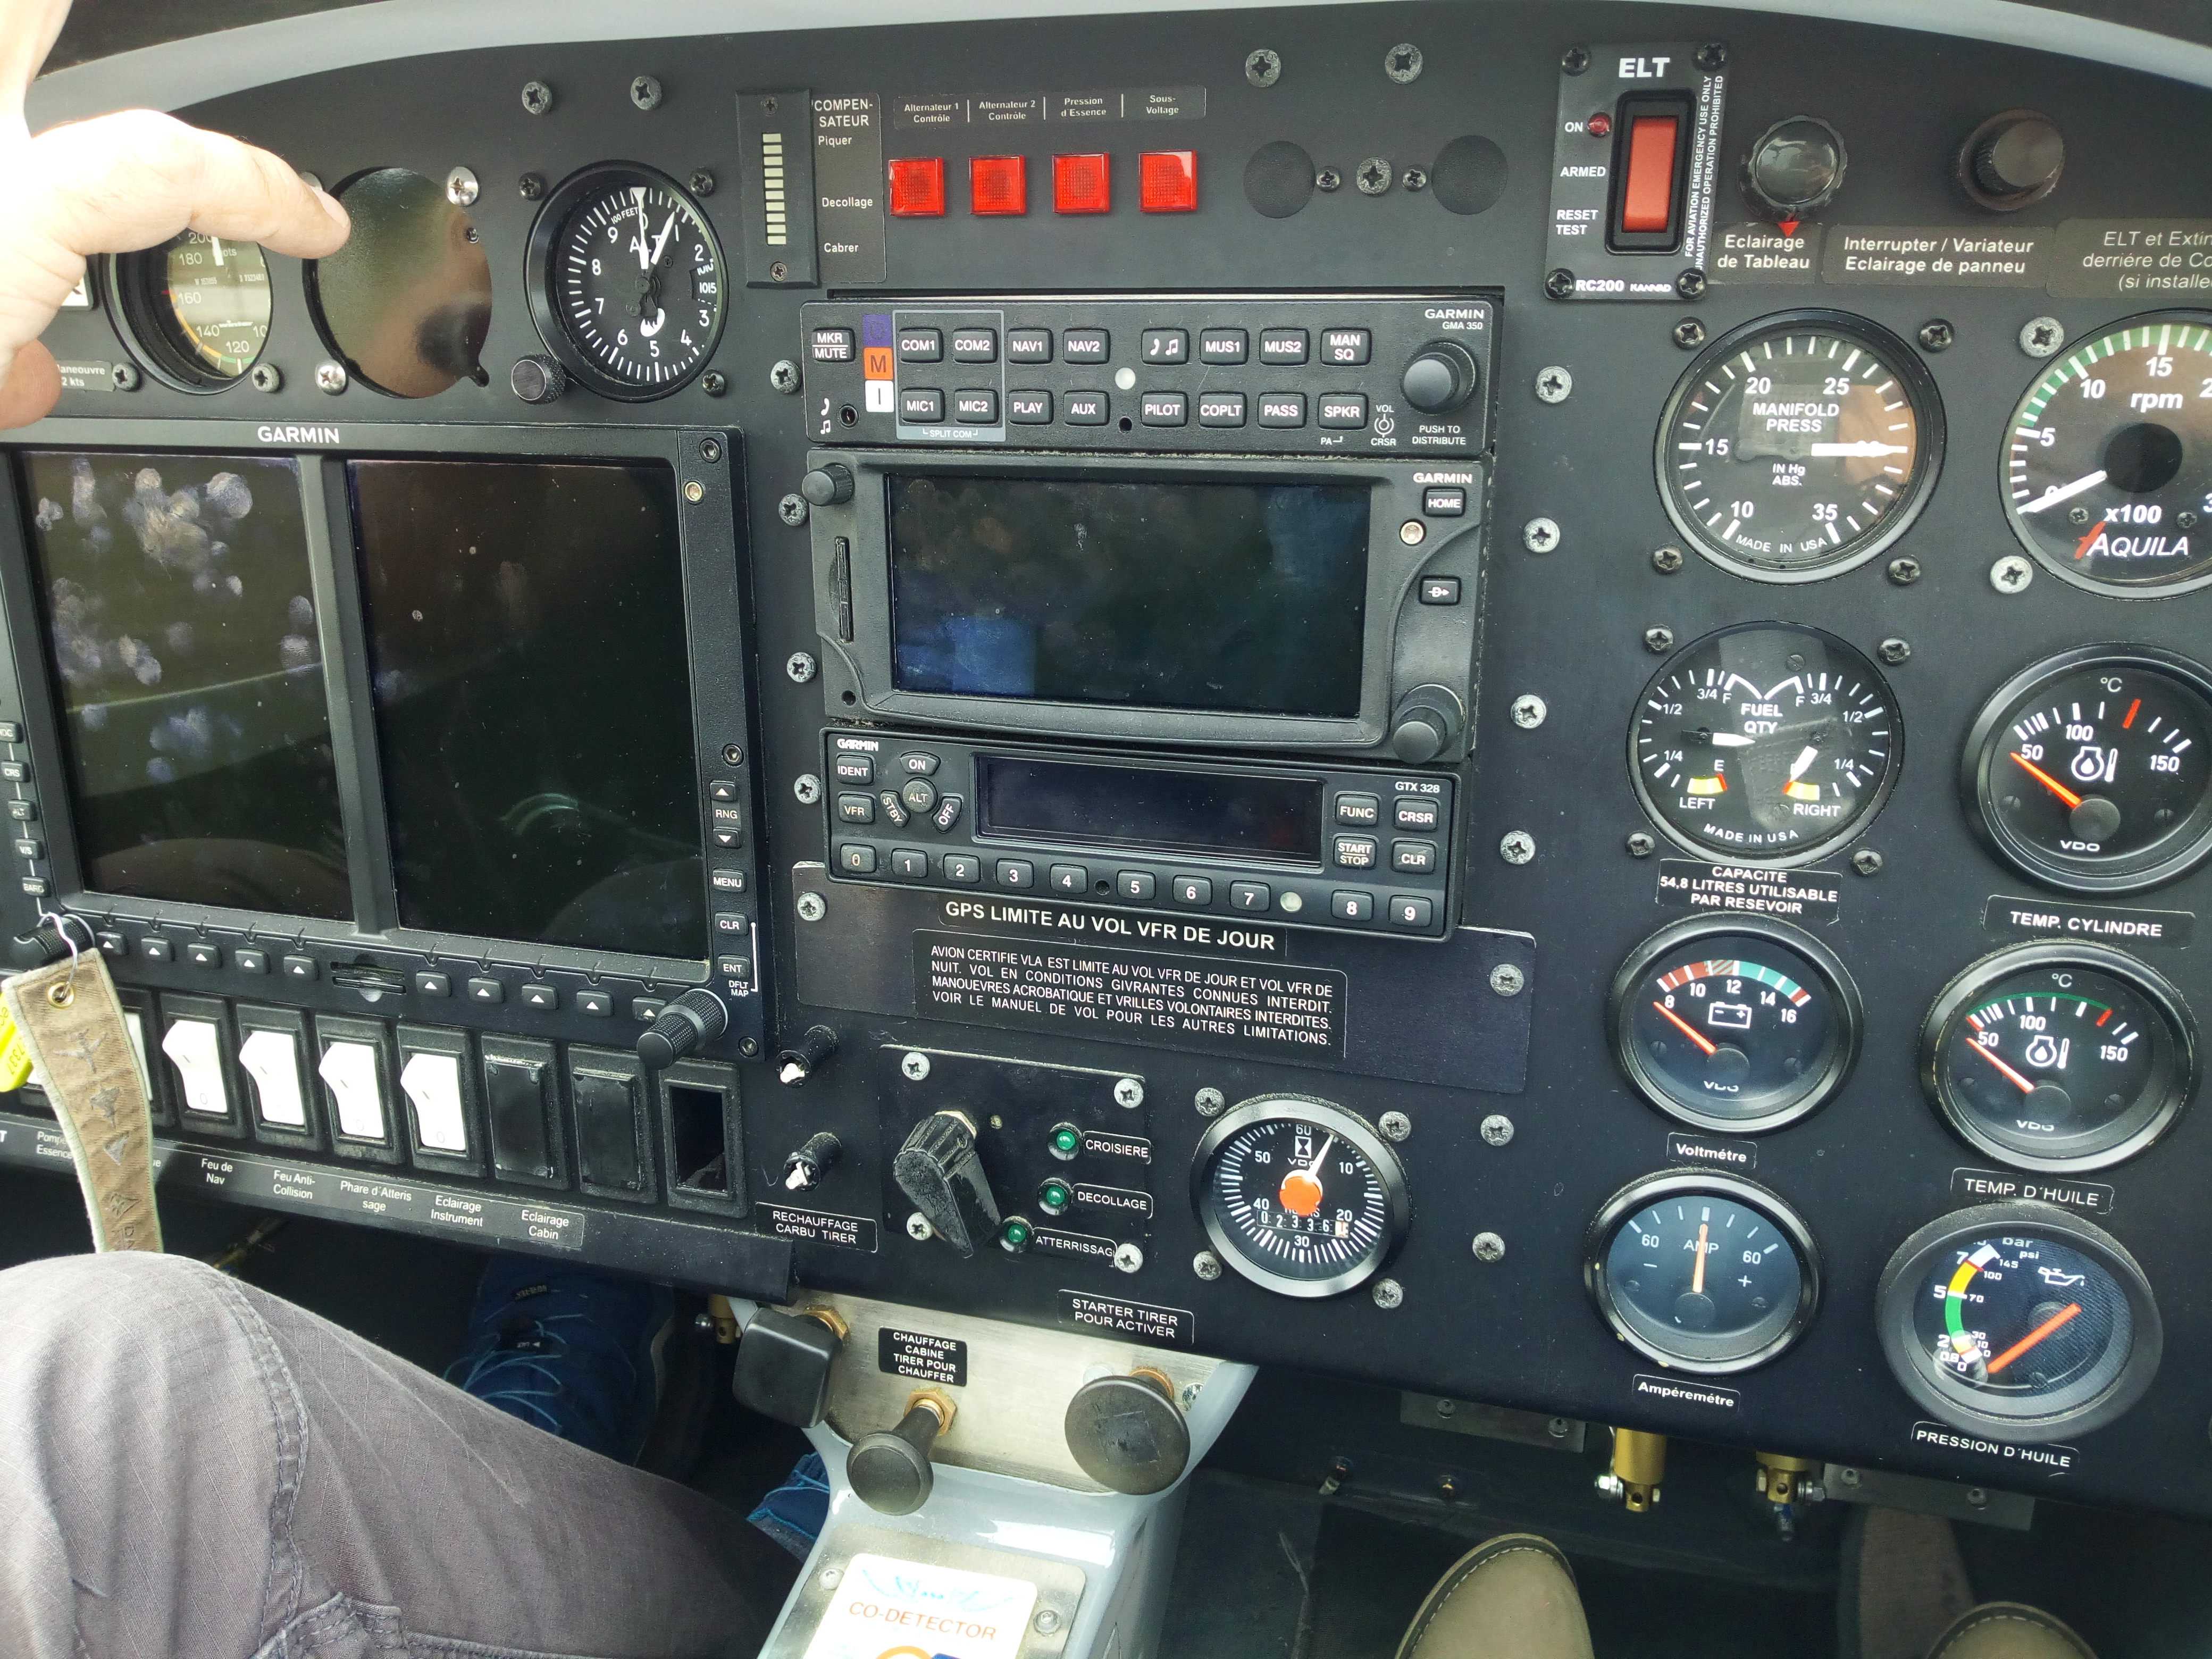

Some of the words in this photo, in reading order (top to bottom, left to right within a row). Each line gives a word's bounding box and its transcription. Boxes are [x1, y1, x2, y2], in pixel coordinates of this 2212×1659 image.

[1619, 57, 1670, 78] ELT
[1702, 76, 1711, 102] ONLY
[814, 99, 873, 111] COMPEN-
[979, 100, 1026, 110] Alternateur
[1150, 95, 1176, 104] Sous-
[904, 103, 952, 112] Alternateur
[1146, 106, 1179, 115] Voltage
[819, 115, 869, 127] SATEUR
[1699, 105, 1708, 125] USE
[1565, 122, 1583, 132] ON
[818, 135, 852, 147] Piquer
[1703, 138, 1716, 194] OPERATION
[1710, 76, 1723, 135] PROHIBITED
[1692, 129, 1706, 188] EMERGENCY
[1560, 167, 1605, 177] ARMED
[822, 197, 873, 208] Decollage
[1557, 210, 1598, 220] RESET
[1687, 192, 1699, 234] AVIATION
[1556, 225, 1587, 234] TEST
[824, 242, 859, 253] Cabrer
[1685, 237, 1694, 256] FOR
[1724, 234, 1804, 251] Eclairage
[1844, 237, 1937, 254] Interrupter
[1952, 238, 2034, 253] Variateur
[1717, 255, 1738, 268] de
[1744, 255, 1809, 269] Tableau
[1845, 256, 1926, 274] Eclairage
[1932, 259, 1953, 273] de
[1958, 259, 2025, 275] panneu
[699, 282, 717, 294] 1015
[1576, 280, 1623, 292] RC200
[1425, 308, 1484, 319] GARMIN
[817, 333, 842, 343] MKR
[1330, 334, 1360, 346] MAN
[901, 340, 935, 351] COM1
[954, 339, 990, 351] COM2
[1012, 340, 1043, 352] NAV1
[1068, 341, 1100, 352] NAV2
[1206, 341, 1240, 353] MUS1
[1264, 341, 1301, 353] MUS2
[815, 348, 847, 358] MUTE
[1334, 348, 1354, 361] SQ
[907, 400, 934, 412] MIC1
[959, 401, 988, 412] MIC2
[1013, 403, 1043, 414] PLAY
[2130, 392, 2183, 413] rpm
[1071, 404, 1096, 414] AUX
[1145, 404, 1180, 415] PILOT
[1201, 404, 1242, 416] COPLT
[1264, 404, 1297, 416] PASS
[1325, 406, 1360, 417] SPKR
[1753, 403, 1839, 417] MANIFOLD
[1766, 419, 1822, 432] PRESS
[257, 426, 340, 444] GARMIN
[929, 429, 950, 438] SPLIT
[953, 429, 972, 438] COM
[1412, 436, 1466, 445] DISTRIBUTE
[1772, 463, 1786, 474] IN
[1788, 463, 1805, 475] Hg
[1413, 473, 1472, 483] GARMIN
[1772, 475, 1802, 486] ABS.
[1428, 498, 1461, 508] HOME
[2086, 533, 2189, 557] AQUILA
[1741, 703, 1783, 717] FUEL
[1744, 721, 1778, 734] QTY
[837, 739, 879, 751] GARMIN
[837, 765, 868, 776] IDENT
[1395, 782, 1418, 792] GTX
[1420, 783, 1440, 793] 328
[1680, 797, 1715, 809] LEFT
[715, 809, 738, 819] RNG
[844, 806, 865, 816] VFR
[1340, 806, 1374, 818] FUNC
[1793, 803, 1841, 817] RIGHT
[1398, 811, 1434, 823] CRSR
[1338, 842, 1372, 854] START
[1340, 855, 1369, 866] STOP
[1401, 853, 1425, 865] CLR
[1712, 866, 1788, 883] CAPACITE
[713, 877, 742, 887] MENU
[1660, 876, 1688, 889] 54,8
[1692, 879, 1745, 895] LITRES
[1749, 884, 1838, 902] UTILISABLE
[1690, 893, 1720, 907] PAR
[1725, 896, 1802, 914] RESEVOIR
[720, 920, 740, 929] CLR
[946, 901, 984, 919] GPS
[991, 906, 1052, 926] LIMITE
[1058, 913, 1085, 929] AU
[1090, 917, 1132, 935] VOL
[1137, 921, 1177, 940] VFR
[1183, 926, 1211, 943] DE
[1217, 930, 1275, 950] JOUR
[2010, 911, 2060, 928] TEMP.
[2067, 917, 2163, 937] CYLINDRE
[723, 963, 742, 973] ENT
[728, 980, 748, 990] DFLT
[932, 960, 961, 974] NUIT.
[969, 964, 993, 977] VOL
[1001, 968, 1017, 979] EN
[1026, 970, 1103, 988] CONDITIONS
[1111, 979, 1184, 997] GIVRANTES
[1193, 987, 1258, 1005] CONNUES
[1267, 995, 1332, 1013] INTERDIT.
[731, 988, 749, 998] MAP
[932, 976, 1010, 994] MANOUEVRES
[1013, 984, 1094, 1003] ACROBATIQUE
[1097, 994, 1112, 1005] ET
[1116, 995, 1163, 1011] VRILLES
[1167, 1000, 1251, 1020] VOLONTAIRES
[1255, 1009, 1331, 1029] INTERDITES.
[1086, 1139, 1148, 1158] CROISIERE
[1255, 1151, 1270, 1163] 50
[201, 1158, 219, 1170] Feu
[221, 1162, 232, 1172] de
[206, 1174, 225, 1185] Nav
[274, 1170, 291, 1181] Feu
[293, 1174, 316, 1185] Anti-
[273, 1184, 313, 1200] Collision
[340, 1180, 369, 1195] Phare
[1965, 1178, 2016, 1196] TEMP.
[362, 1200, 387, 1212] sage
[435, 1195, 481, 1213] Eclairage
[1077, 1191, 1147, 1210] DECOLLAGE
[431, 1209, 483, 1227] Instrument
[521, 1210, 569, 1227] Eclairage
[773, 1210, 858, 1233] RECHAUFFAGE
[529, 1226, 559, 1240] Cabin
[776, 1223, 816, 1237] CARBU
[822, 1229, 857, 1244] TIRER
[1641, 1234, 1660, 1248] 60
[2020, 1250, 2039, 1260] psi
[1999, 1259, 2018, 1269] 145
[1073, 1298, 1133, 1318] STARTER
[1137, 1310, 1178, 1326] TIRER
[1075, 1312, 1113, 1327] POUR
[1116, 1319, 1175, 1338] ACTIVER
[893, 1332, 956, 1351] CHAUFFAGE
[905, 1345, 944, 1359] CABINE
[894, 1353, 924, 1367] TIRER
[927, 1360, 956, 1372] POUR
[898, 1365, 954, 1382] CHAUFFER
[1916, 1430, 1999, 1455] PRESSION
[849, 1602, 996, 1640] CO-DETECTOR
